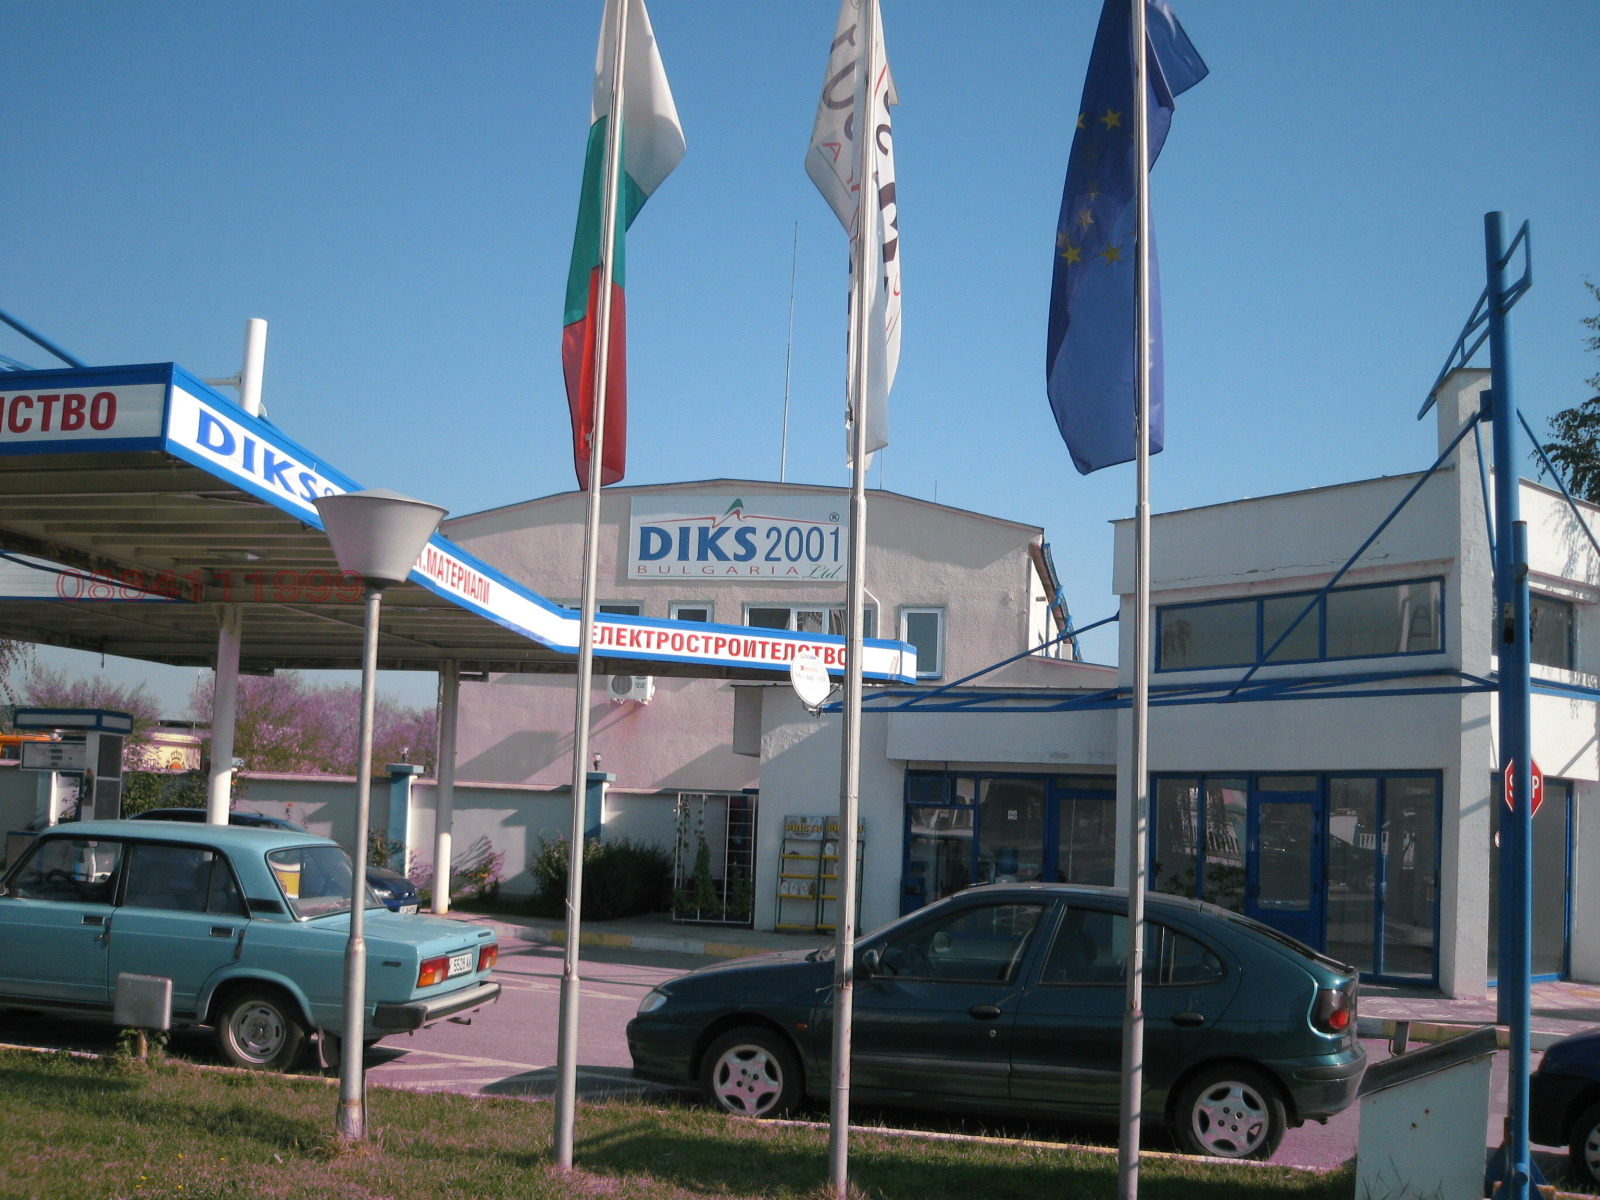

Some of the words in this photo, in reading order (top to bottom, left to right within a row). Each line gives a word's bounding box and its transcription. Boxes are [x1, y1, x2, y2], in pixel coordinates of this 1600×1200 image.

[0, 392, 117, 433] СТВО
[638, 526, 757, 562] DIKS
[764, 526, 840, 562] 2001
[637, 565, 799, 575] BULGARIA
[802, 564, 844, 579] Ltd.
